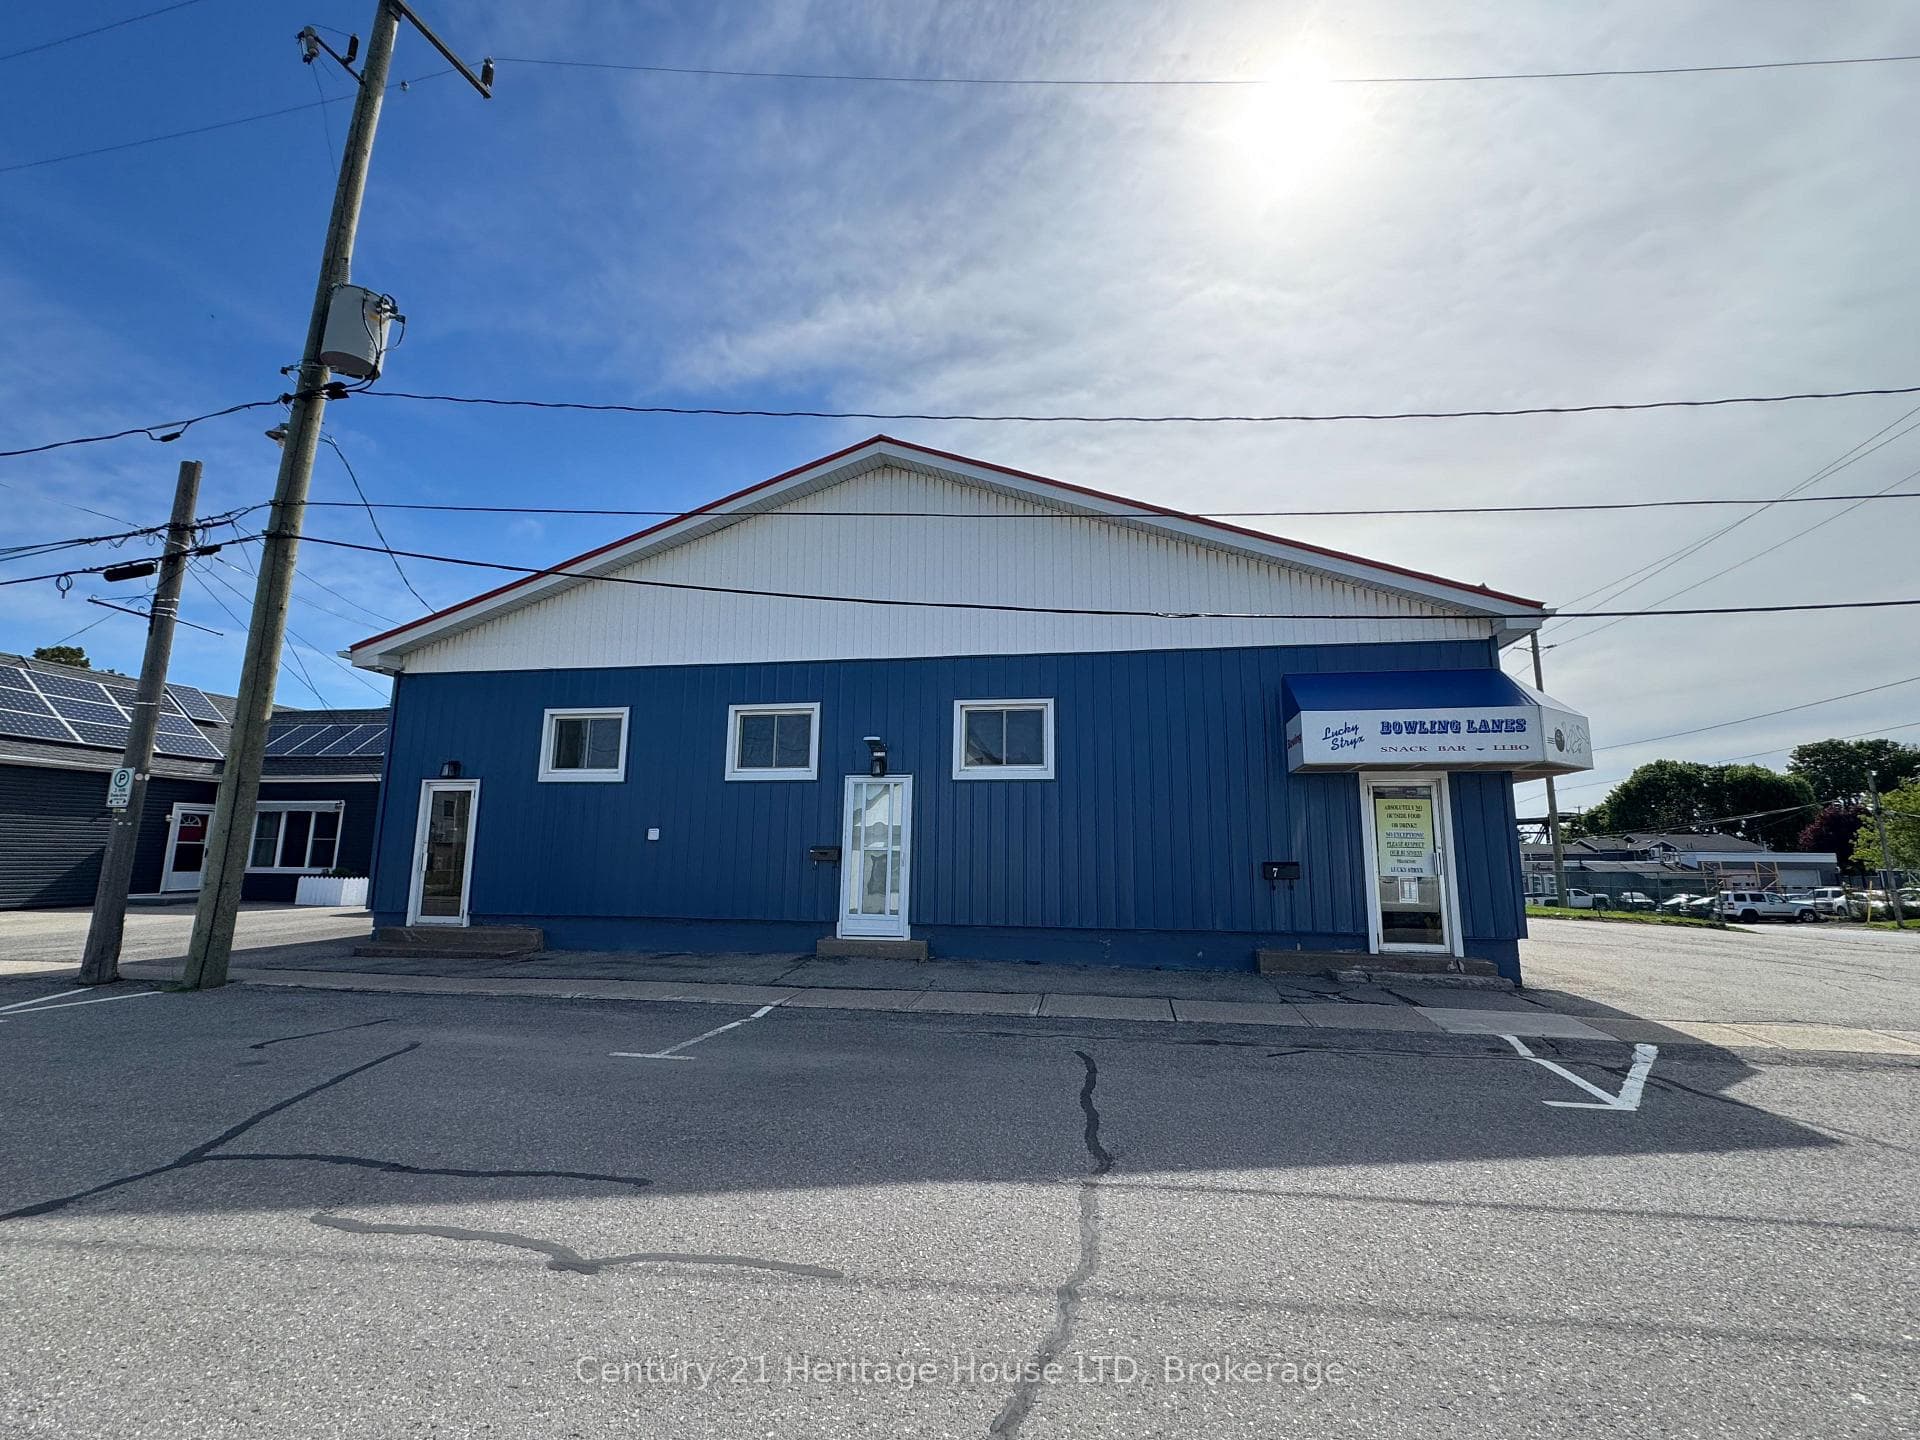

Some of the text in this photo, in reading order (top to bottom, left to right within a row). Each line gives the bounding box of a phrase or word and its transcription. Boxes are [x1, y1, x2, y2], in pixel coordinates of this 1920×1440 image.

[1322, 721, 1359, 741] Lucky
[1380, 718, 1527, 735] BOWLING LANES
[1331, 736, 1365, 751] Stryx
[1272, 867, 1279, 877] 7
